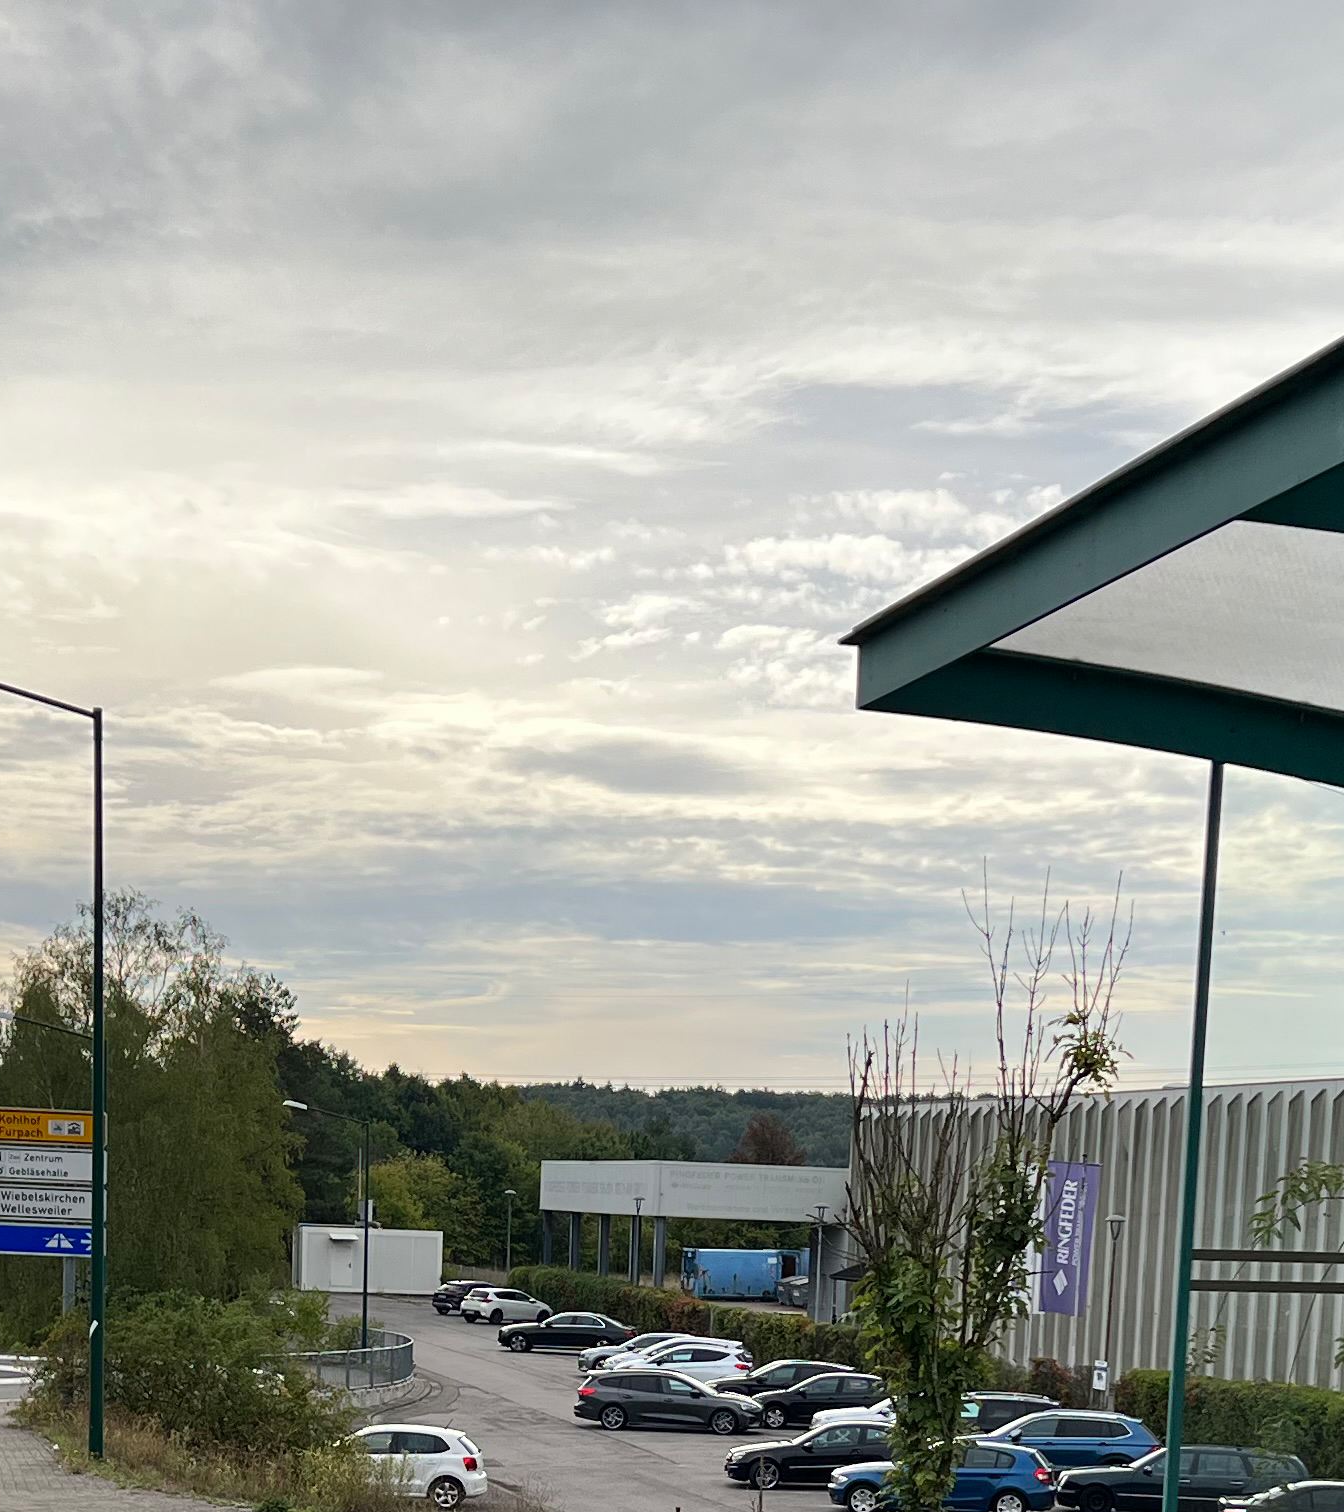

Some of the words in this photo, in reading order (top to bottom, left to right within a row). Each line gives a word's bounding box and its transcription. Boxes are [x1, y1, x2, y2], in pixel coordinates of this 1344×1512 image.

[24, 1153, 63, 1163] Zentrum
[9, 1167, 69, 1177] Gebläsehalle
[1, 1190, 86, 1204] Wiebelskirchen
[1, 1203, 72, 1216] Wellesweiler
[1056, 1179, 1079, 1265] RINGFEDER
